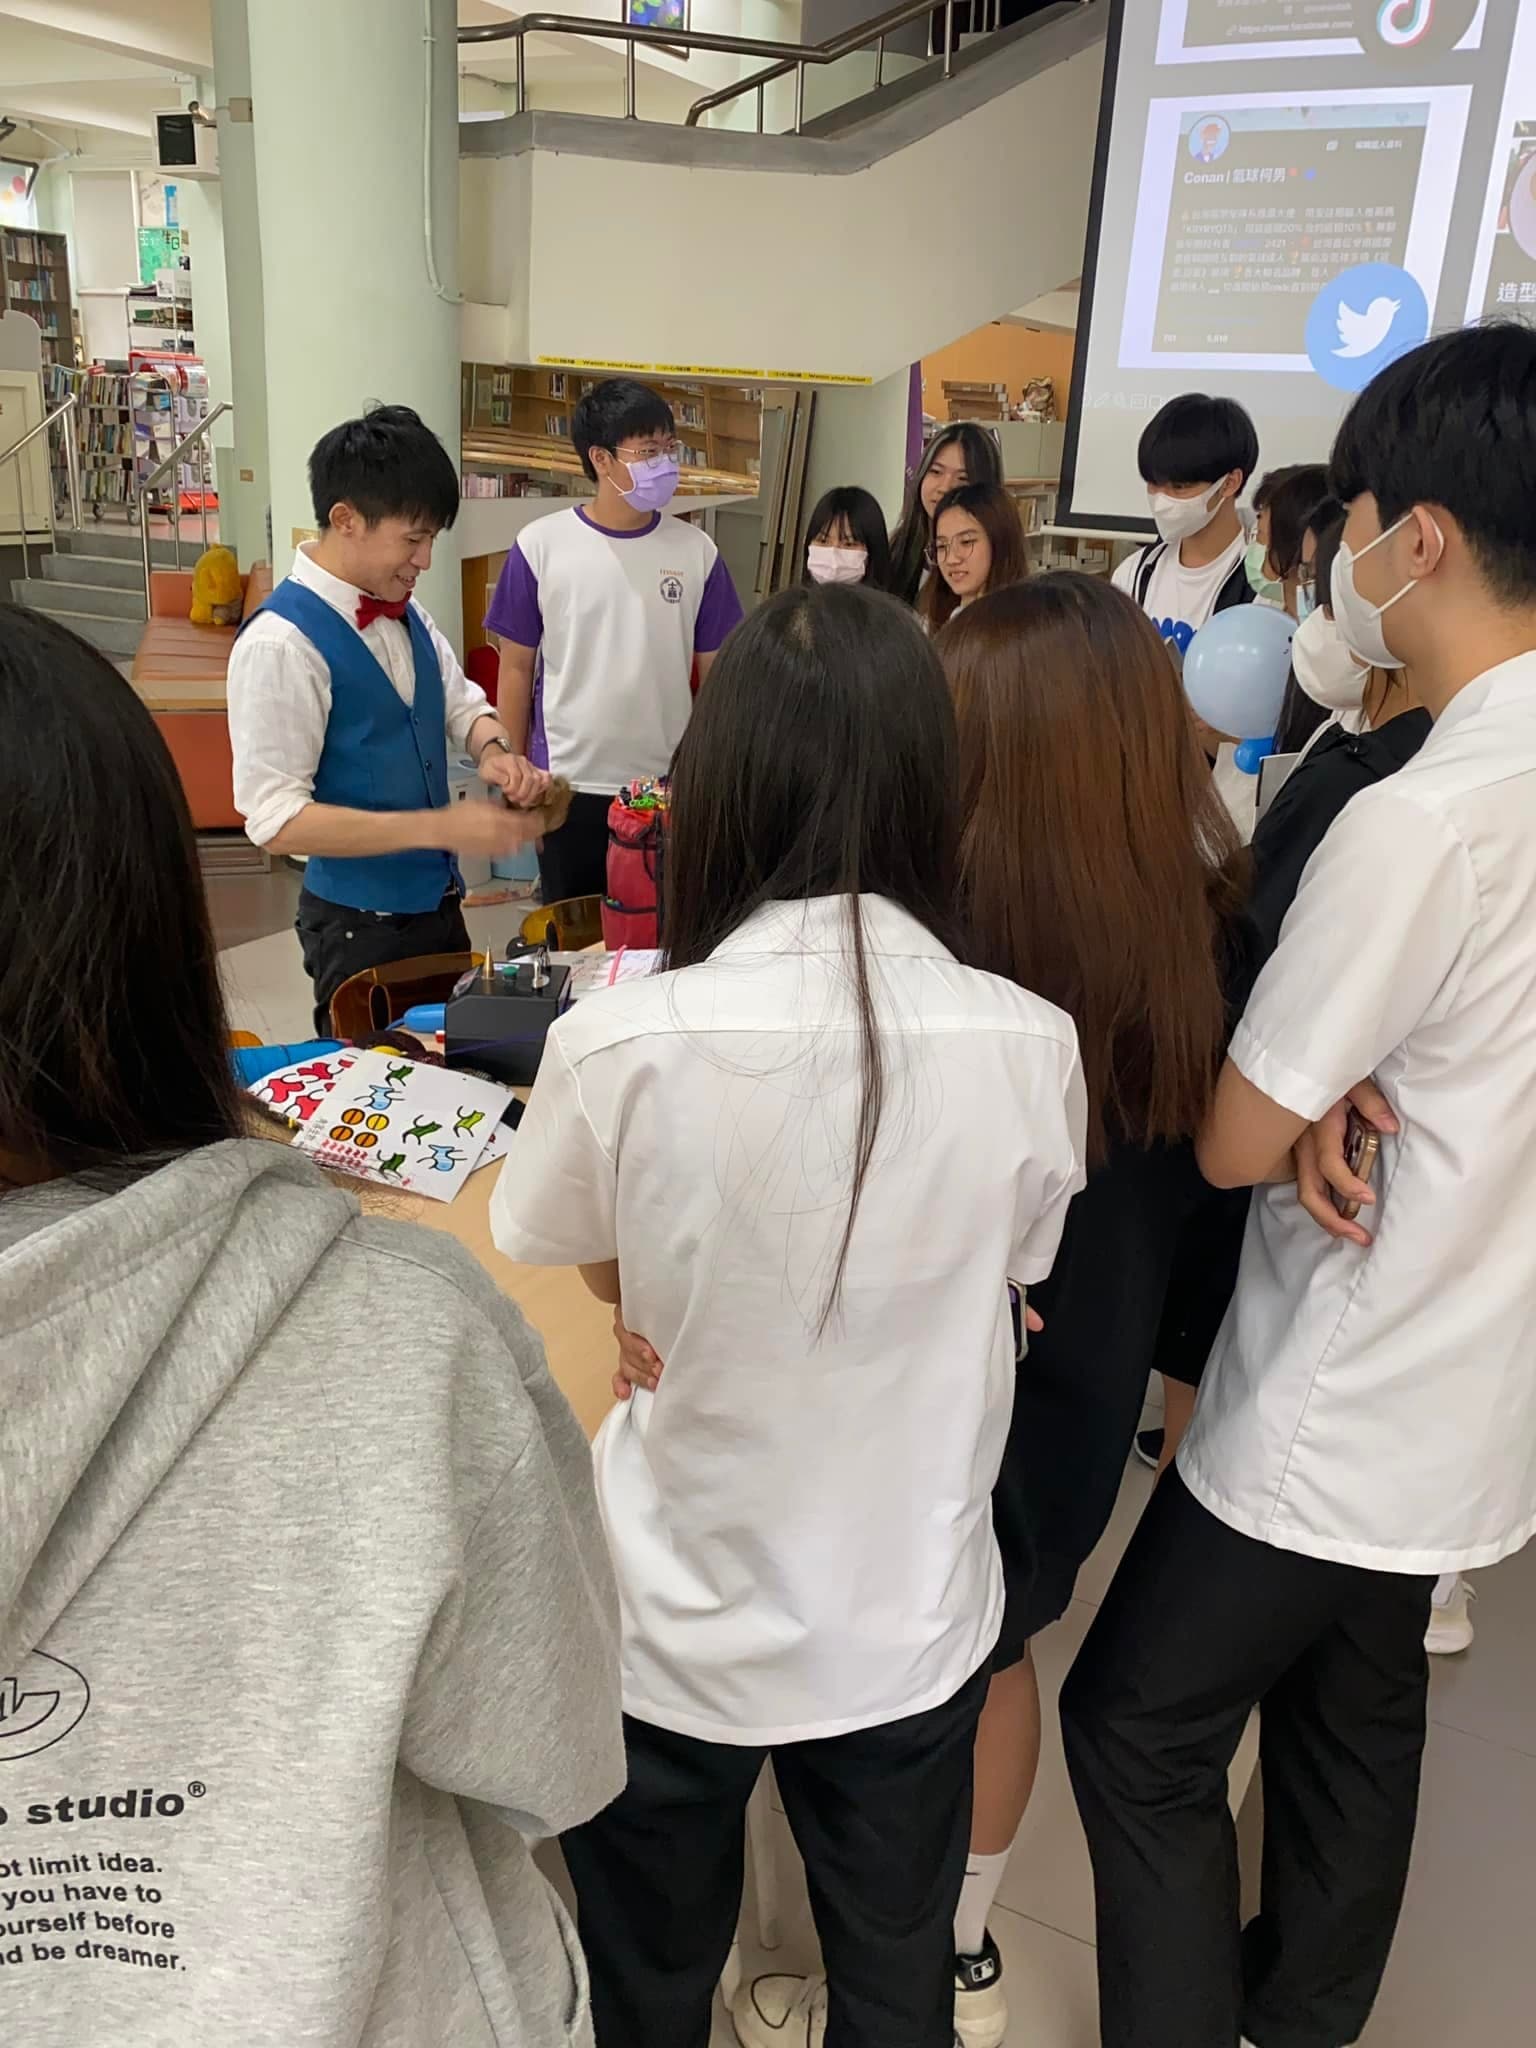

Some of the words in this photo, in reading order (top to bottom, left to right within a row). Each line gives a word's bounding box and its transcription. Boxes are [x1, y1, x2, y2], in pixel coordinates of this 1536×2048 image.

[1183, 170, 1224, 185] Conan
[29, 1854, 92, 1875] limit
[98, 1852, 162, 1872] idea.
[2, 1889, 54, 1911] you
[63, 1883, 128, 1902] have
[135, 1884, 162, 1904] to
[94, 1911, 175, 1939] before
[31, 1943, 65, 1961] be
[75, 1939, 187, 1972] dreamer.
